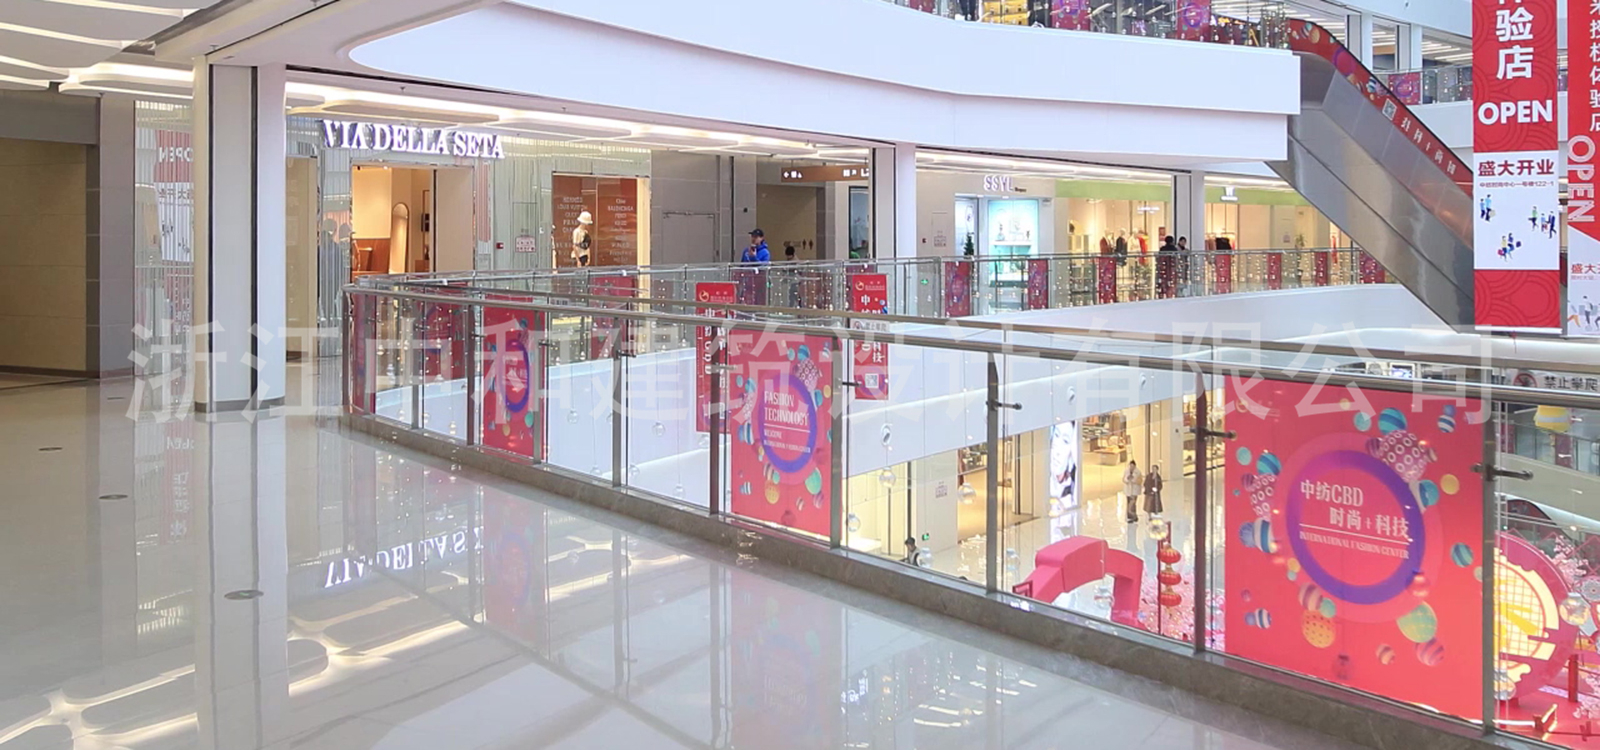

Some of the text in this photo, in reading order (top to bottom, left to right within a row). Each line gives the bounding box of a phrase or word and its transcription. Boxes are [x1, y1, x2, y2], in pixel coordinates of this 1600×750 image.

[1478, 100, 1553, 125] OPEN
[323, 119, 505, 158] VIA DELLA SETA
[1478, 159, 1554, 177] 盛大开业
[1567, 135, 1597, 222] OPEN
[984, 174, 1013, 192] SSYL
[764, 391, 795, 407] FASHION
[764, 407, 810, 426] TECHNOLOGY
[1300, 479, 1364, 507] 中纺CBD
[1299, 531, 1410, 560] INTERNATIONAL FASHION CENTER
